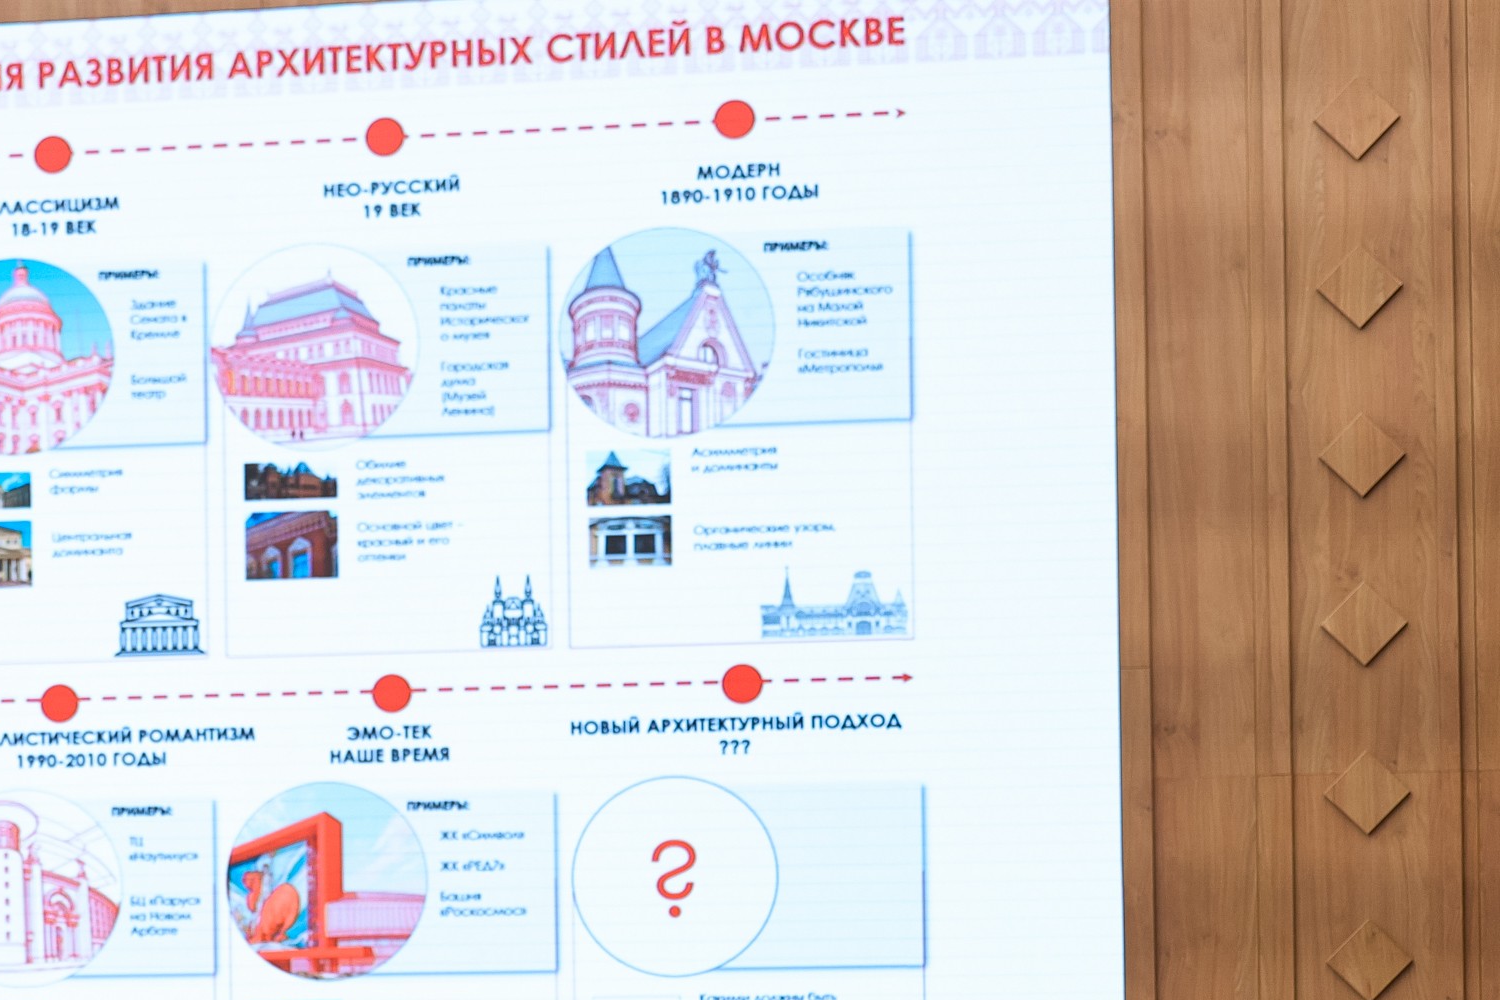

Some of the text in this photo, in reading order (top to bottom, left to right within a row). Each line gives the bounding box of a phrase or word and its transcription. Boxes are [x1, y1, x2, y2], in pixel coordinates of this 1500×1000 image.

[37, 51, 215, 90] РАЗВИТИЯ
[226, 34, 534, 80] АРХИТЕКТУРНЫХ
[545, 19, 692, 65] СТИЛЕЙ
[704, 24, 727, 56] В
[738, 15, 906, 54] МОСКВЕ
[696, 162, 781, 181] МОДЕРН
[323, 173, 461, 199] НЕО-РУССКИЙ
[661, 183, 820, 206] 1890-1910 ГОДЫ
[363, 202, 421, 219] 19 ВЕК
[11, 219, 97, 238] 18-19 ВЕК
[570, 711, 903, 736] НОВЫЙ АРХИТЕКТУРНЫЙ ПОДХОД
[138, 726, 256, 744] РОМАНТИЗМ
[347, 724, 432, 742] ЭМО-ТЕК
[329, 746, 451, 764] НАШЕ ВРЕМЯ
[718, 738, 752, 756] ???
[17, 751, 167, 769] 1990-2010 ГОДЫ
